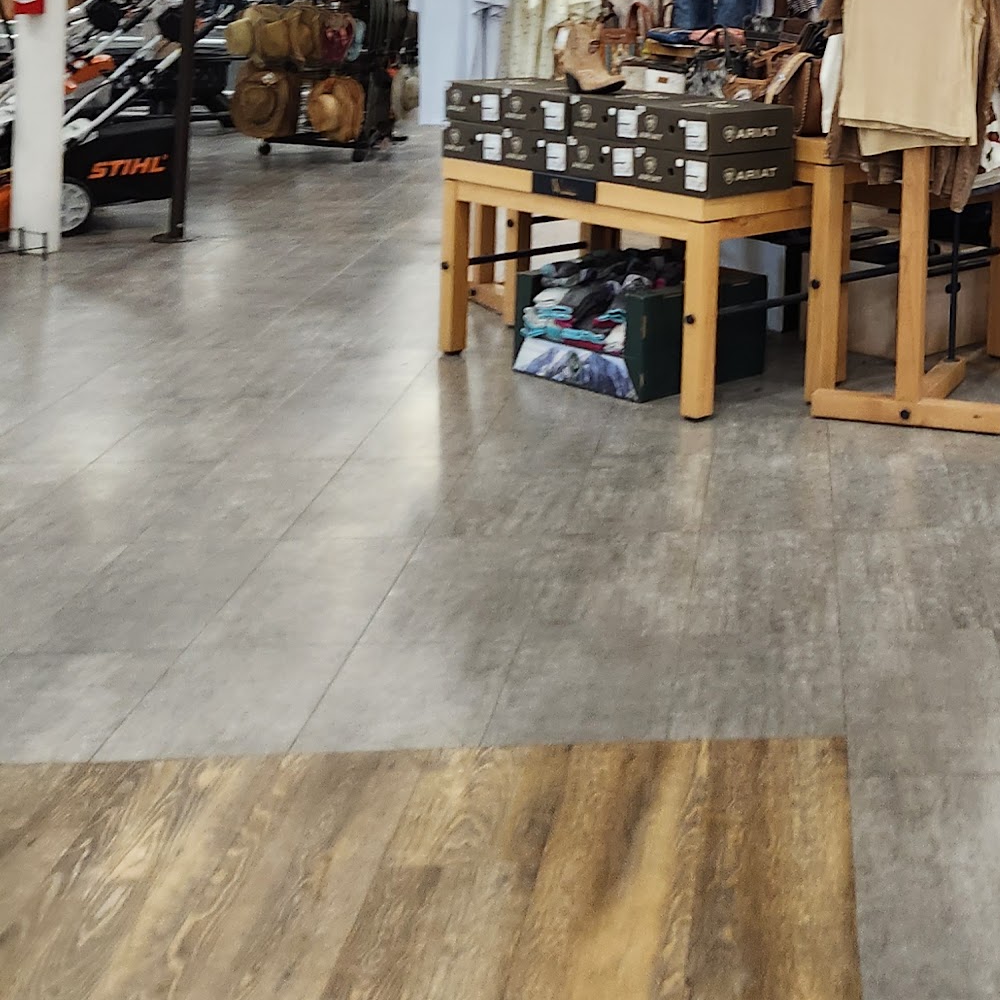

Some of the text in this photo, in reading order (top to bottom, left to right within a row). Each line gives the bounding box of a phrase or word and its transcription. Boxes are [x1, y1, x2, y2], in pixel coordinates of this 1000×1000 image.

[735, 126, 778, 140] ARIAT
[88, 155, 166, 179] STIHL
[734, 167, 778, 182] ARIAT
